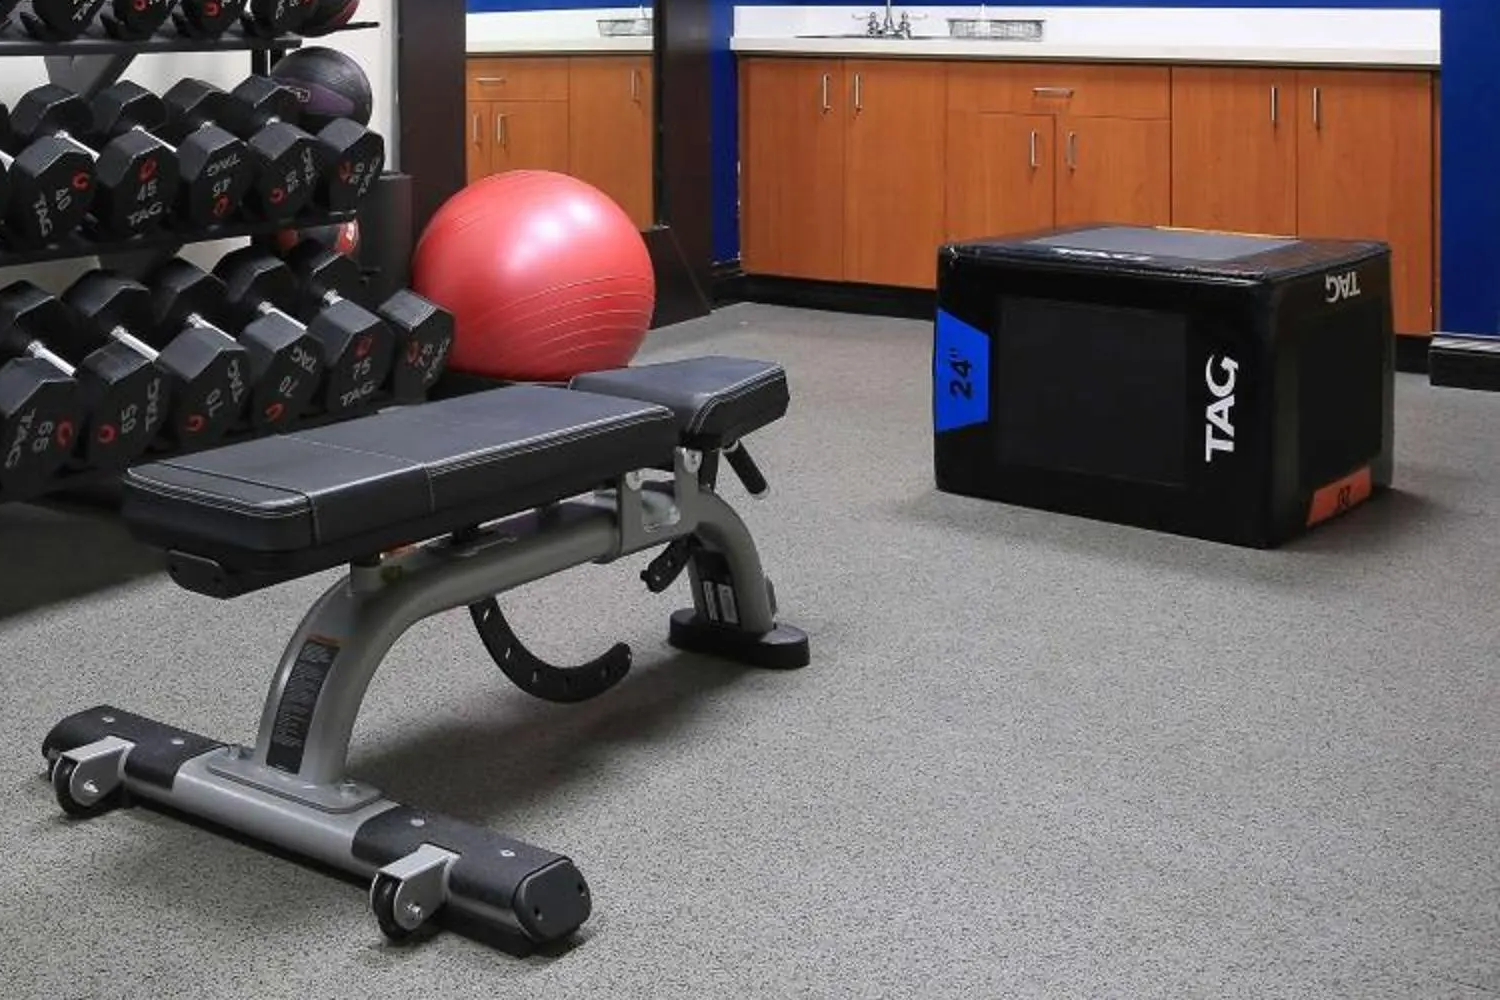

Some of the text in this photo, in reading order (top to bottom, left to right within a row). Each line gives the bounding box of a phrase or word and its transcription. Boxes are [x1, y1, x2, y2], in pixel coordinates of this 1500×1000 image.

[56, 187, 72, 211] 40
[1325, 271, 1361, 302] TAG
[121, 403, 138, 433] 65
[1205, 353, 1239, 462] TAG
[5, 407, 37, 469] TAG
[32, 421, 54, 453] 65
